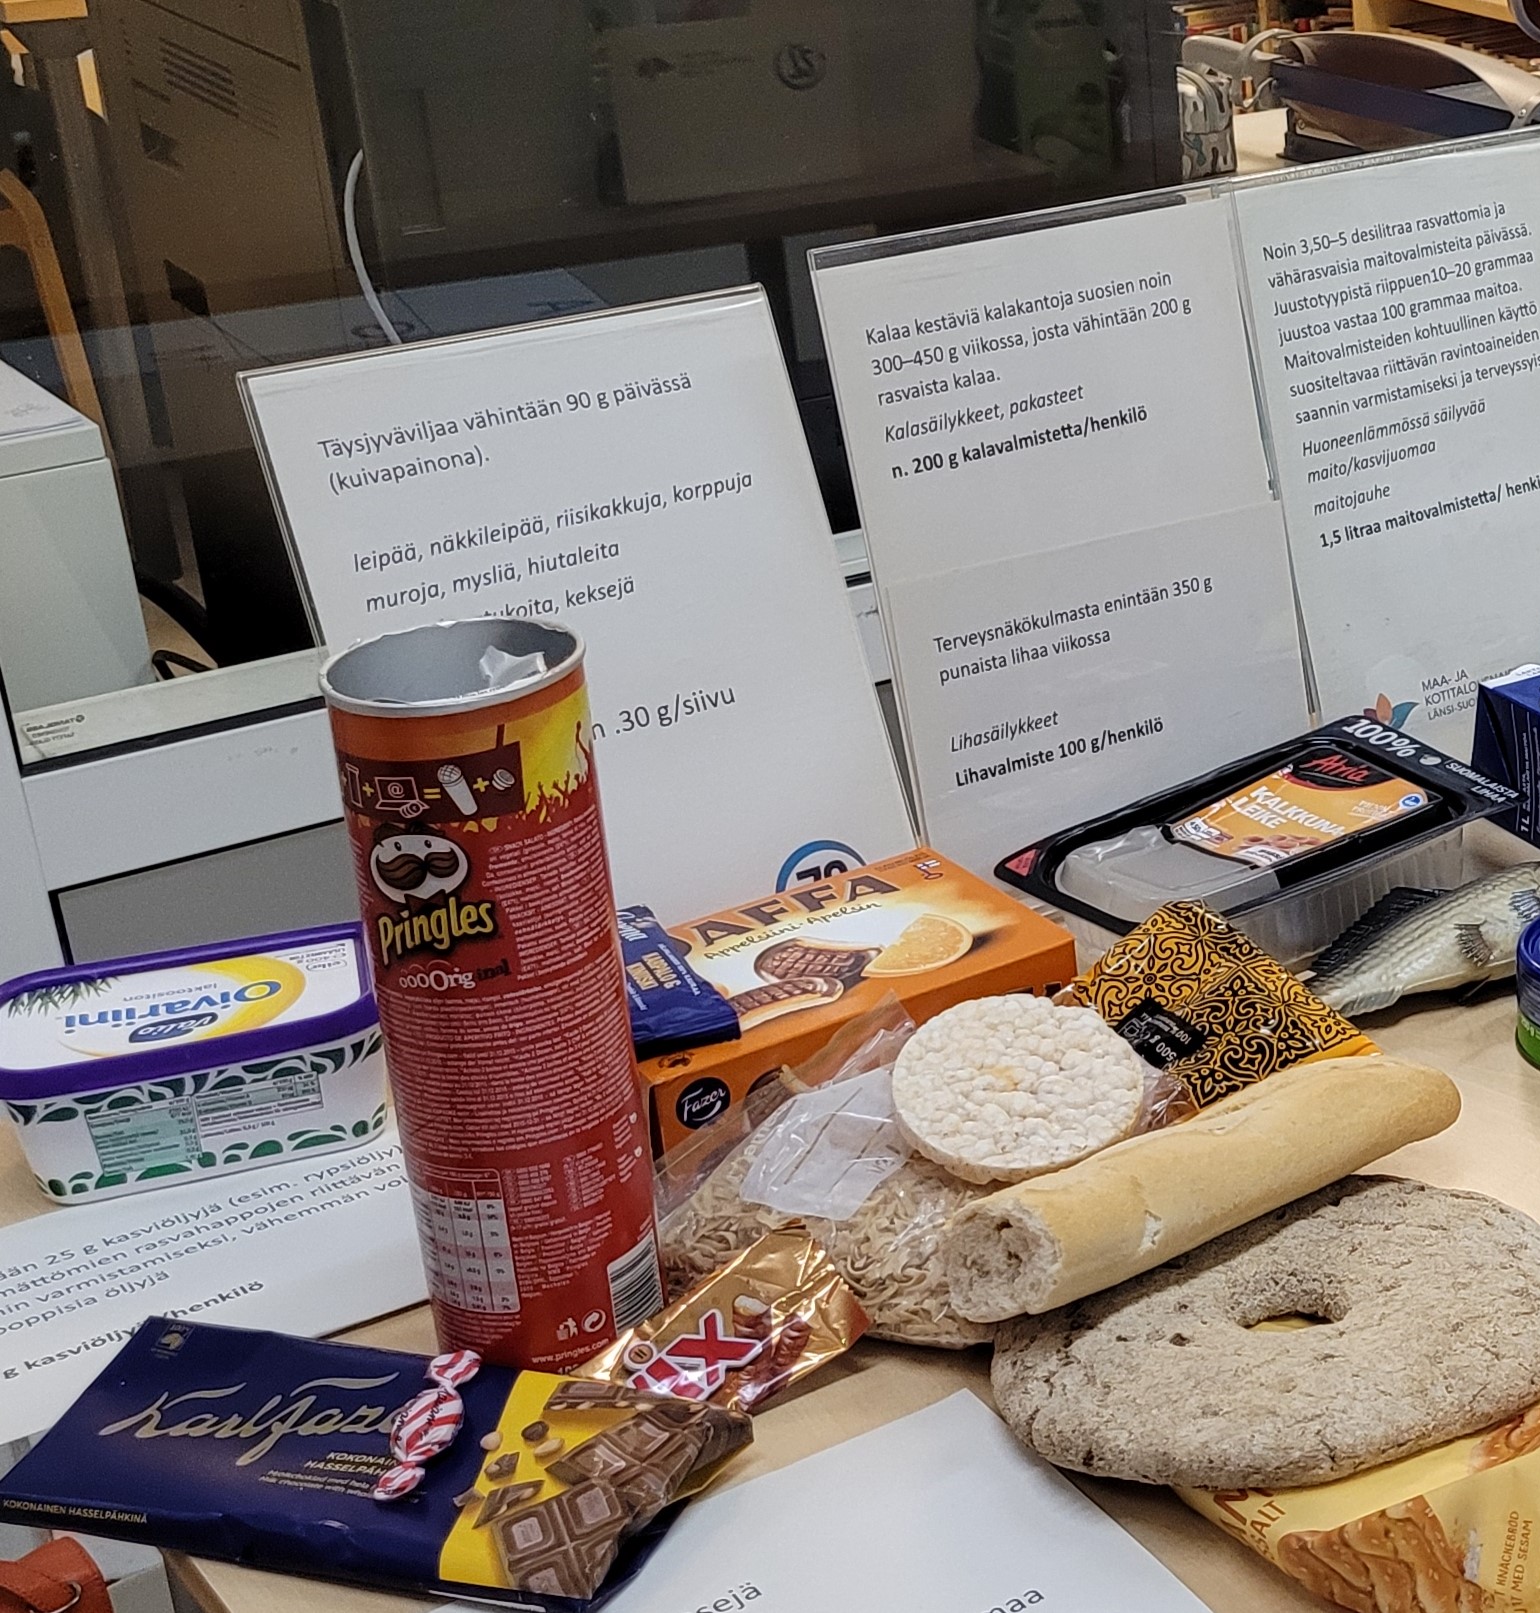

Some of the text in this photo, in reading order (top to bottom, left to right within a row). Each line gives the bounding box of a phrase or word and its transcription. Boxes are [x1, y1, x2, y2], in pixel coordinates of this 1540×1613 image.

[1262, 201, 1506, 262] Noin 3,50–5 desilitraa rasvattomia ja
[865, 271, 1172, 346] Kalaa kestäviä kalakantoja suosien noin
[1277, 281, 1523, 348] juustoa vastaa 100 grammaa maitoa.
[871, 297, 1192, 376] 300–450 g viikossa, josta vähintään 200 g
[316, 372, 692, 459] Täysjyväviljaa vähintään 90 g päivässä
[891, 405, 1148, 480] n. 200 g kalavalmistetta/henkilö
[329, 444, 490, 496] (kuivapainona).
[1307, 441, 1436, 484] maito/kasvijuomaa
[353, 471, 752, 573] leipää, näkkileipää, riisikakkuja, korppuja
[1319, 529, 1342, 549] 1,5
[1344, 521, 1382, 542] litraa
[1384, 483, 1502, 531] maitovalmistetta/
[932, 577, 1213, 653] Terveysnäkökulmasta enintään 350 g
[1421, 668, 1470, 692] MAA- JA
[955, 716, 1164, 787] Lihavalmiste 100 g/henkilö
[1341, 718, 1421, 759] 100%
[1445, 760, 1518, 799] SUOMALAISTA
[1470, 785, 1507, 804] LIHAA
[1230, 796, 1289, 831] LEIKE
[1249, 785, 1346, 838] KALKKUNA-
[377, 896, 494, 967] Pringles
[690, 875, 902, 948] AFFA
[63, 980, 282, 1035] Oivariini
[122, 981, 219, 1003] laktoositon
[138, 1015, 214, 1037] Valio
[680, 1085, 728, 1122] Fazer
[531, 1337, 610, 1365] www.pringles.com
[68, 1505, 149, 1526] HASSELPÄHKINÄ
[1510, 1519, 1534, 1593] MED SESAM
